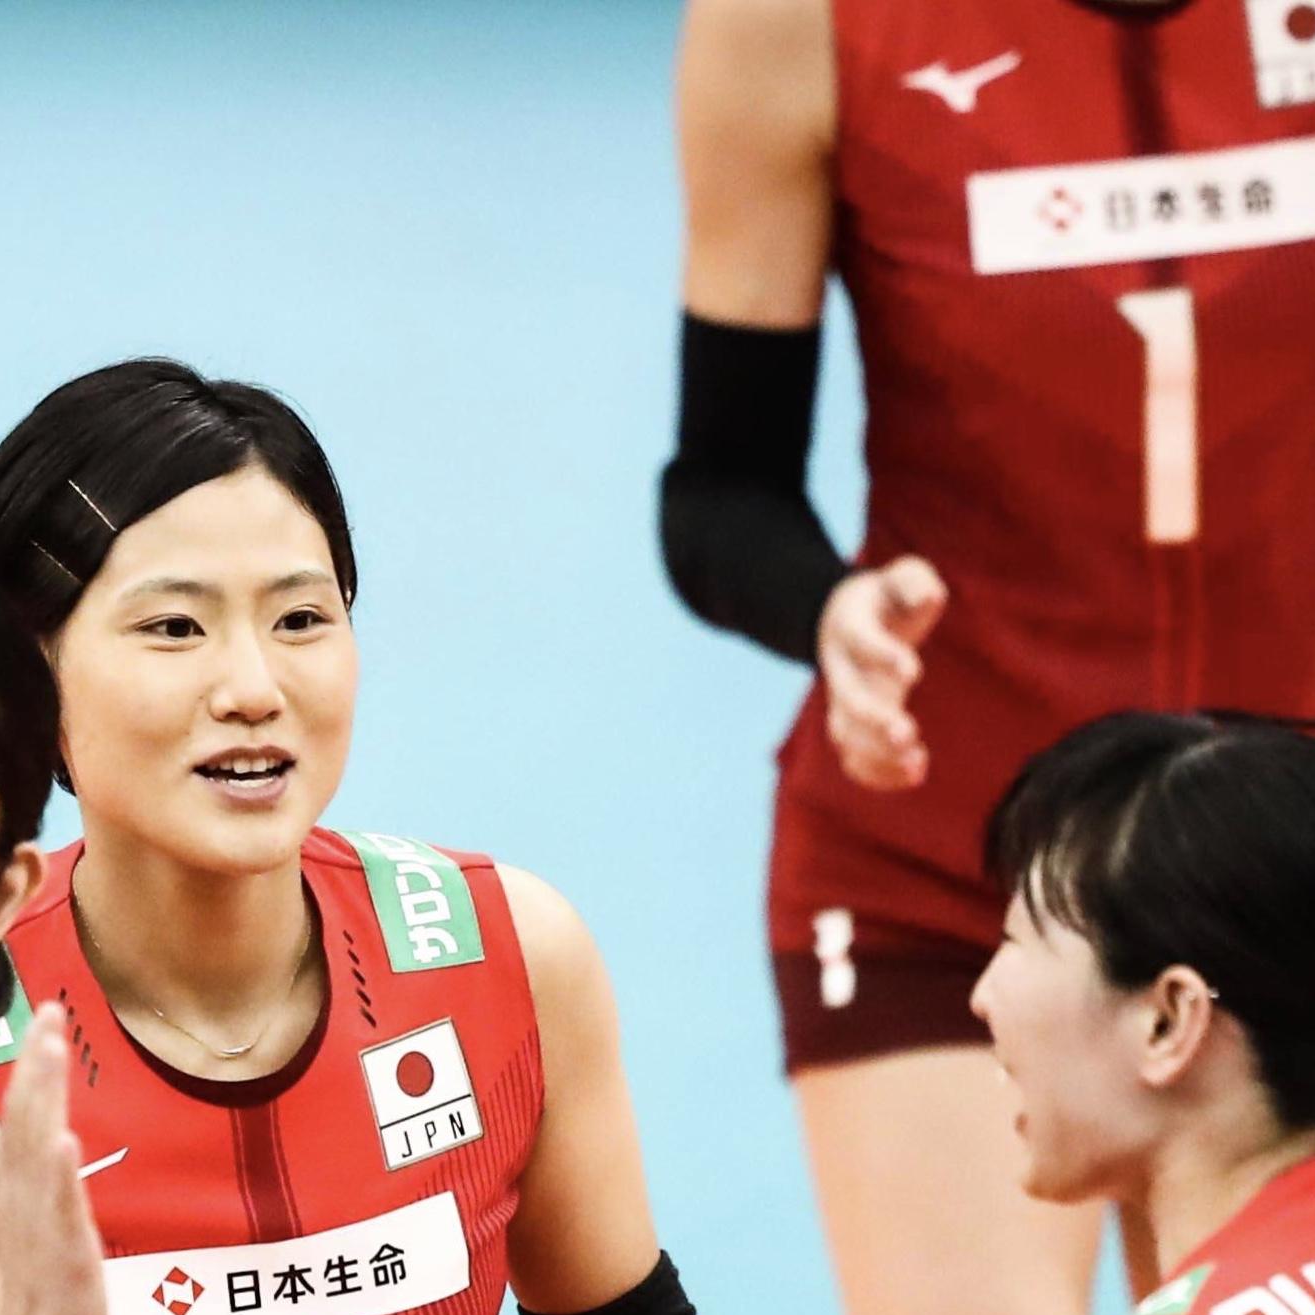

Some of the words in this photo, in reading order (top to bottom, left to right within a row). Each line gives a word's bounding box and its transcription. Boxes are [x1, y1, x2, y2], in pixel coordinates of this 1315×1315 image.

[1117, 287, 1198, 542] 1
[401, 1110, 466, 1159] JPN
[226, 1242, 407, 1314] 日本生命
